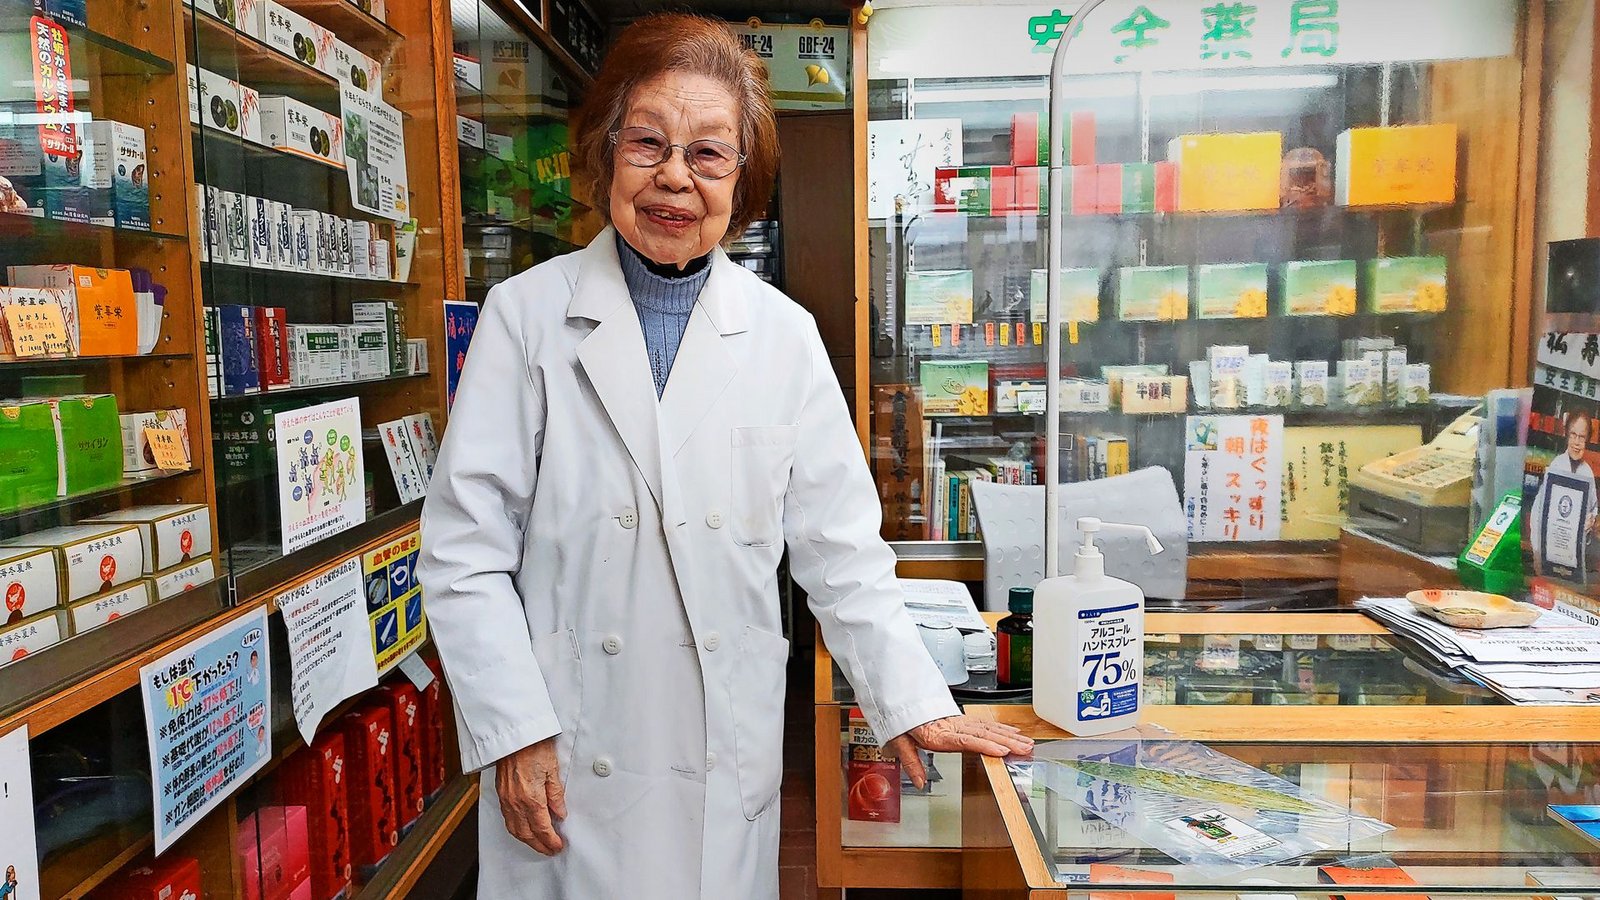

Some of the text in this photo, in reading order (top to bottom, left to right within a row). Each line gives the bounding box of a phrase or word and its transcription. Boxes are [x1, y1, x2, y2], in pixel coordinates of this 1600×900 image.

[1027, 1, 1341, 63] 安全薬局
[798, 36, 835, 54] GBE-24
[120, 146, 146, 160] ササカール
[87, 535, 123, 554] 青海冬夏泉
[1091, 624, 1131, 639] アルコール
[1082, 636, 1137, 652] ハンドスプレー
[153, 653, 196, 689] もし体温が
[1082, 651, 1137, 688] 75%
[854, 727, 875, 736] 視力、
